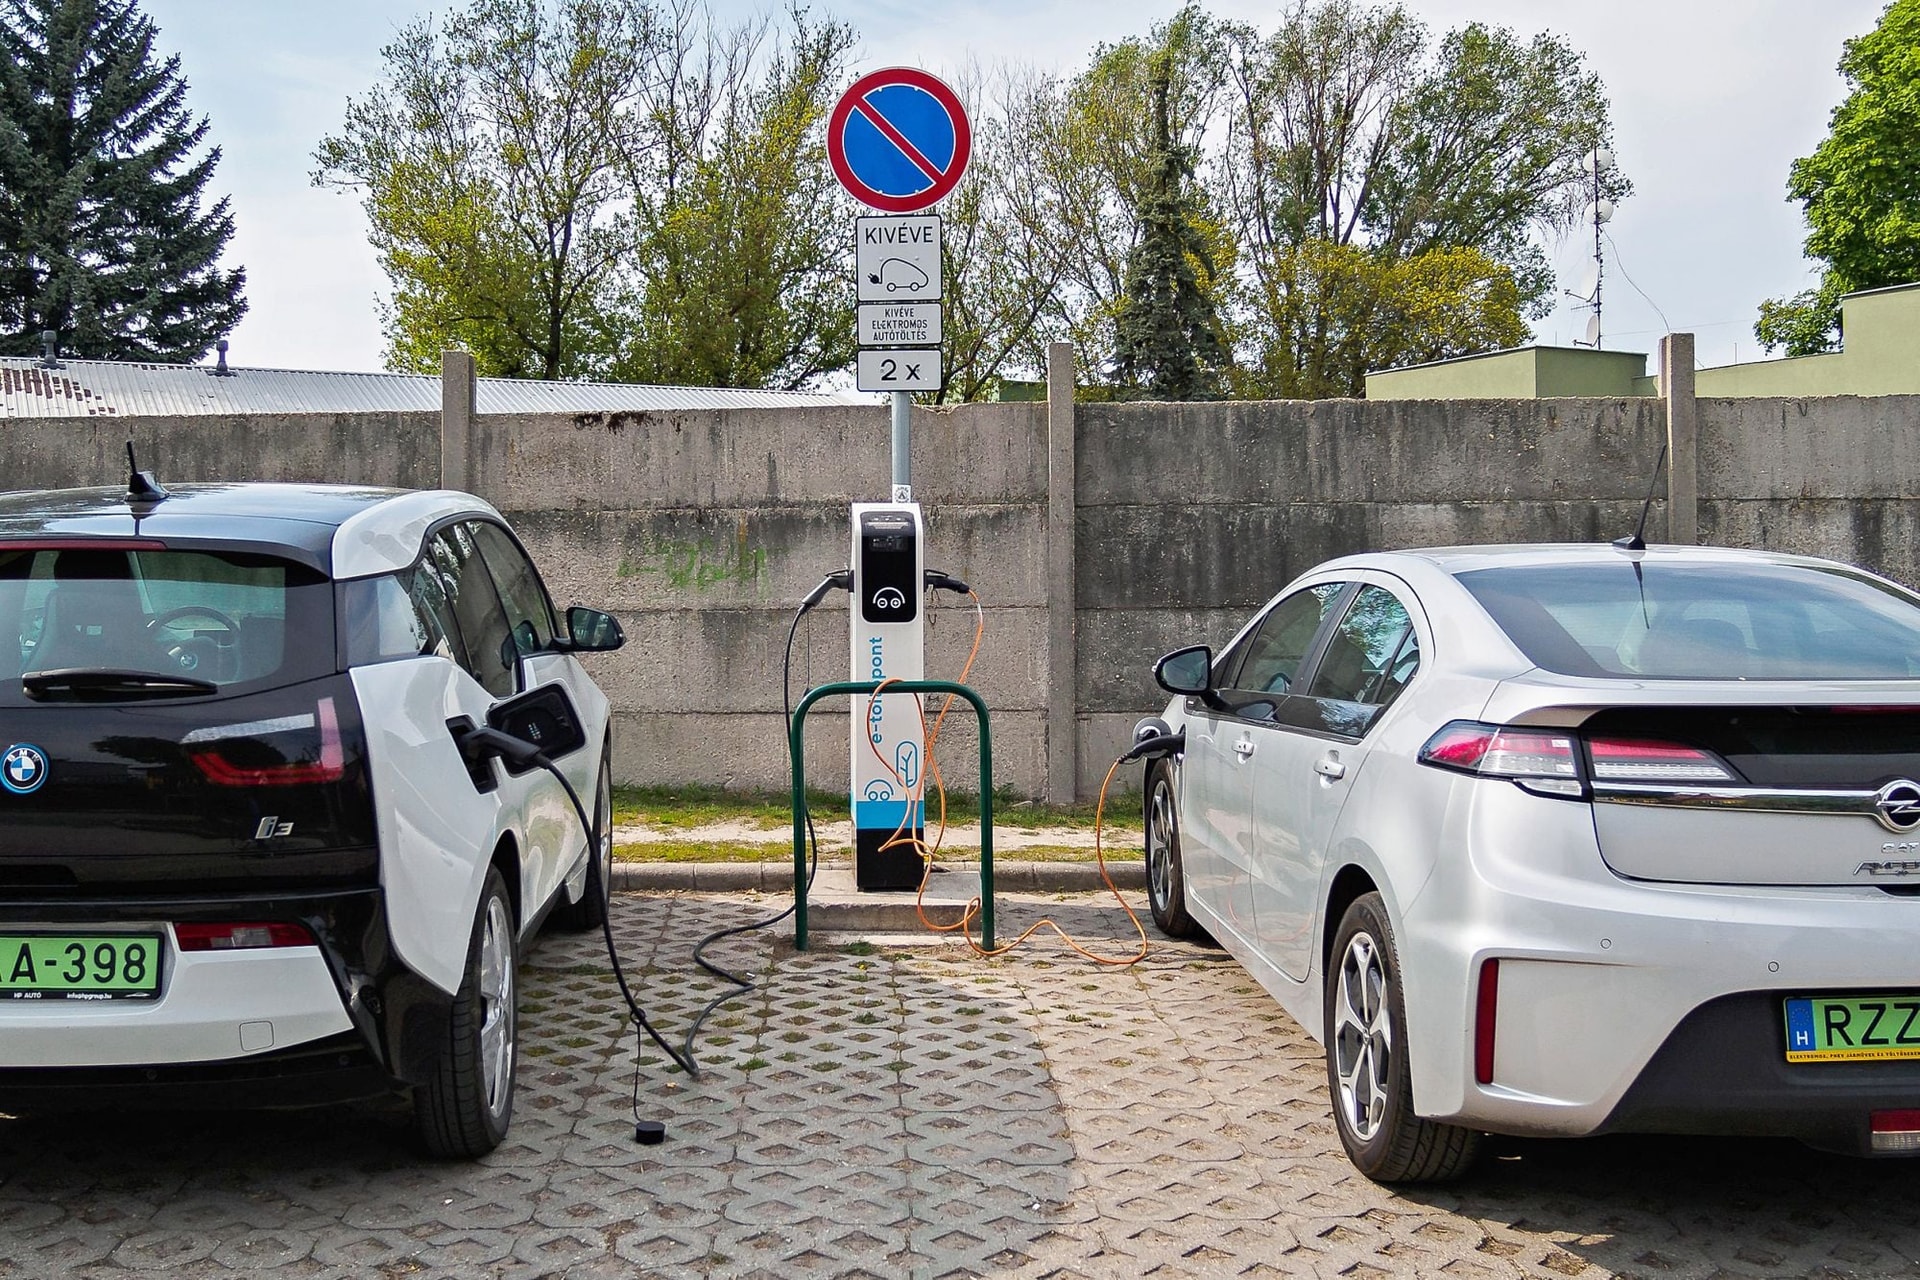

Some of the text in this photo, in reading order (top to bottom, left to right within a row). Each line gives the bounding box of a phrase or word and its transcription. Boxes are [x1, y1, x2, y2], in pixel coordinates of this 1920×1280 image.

[865, 222, 933, 244] KIVÉVE
[885, 306, 914, 318] KIVÉVE
[872, 319, 928, 330] ELEKTROMOS
[873, 330, 927, 341] AUTÓTÖLTÉS
[881, 359, 897, 381] 2
[1824, 1003, 1920, 1046] RZZ
[1796, 1030, 1809, 1046] H
